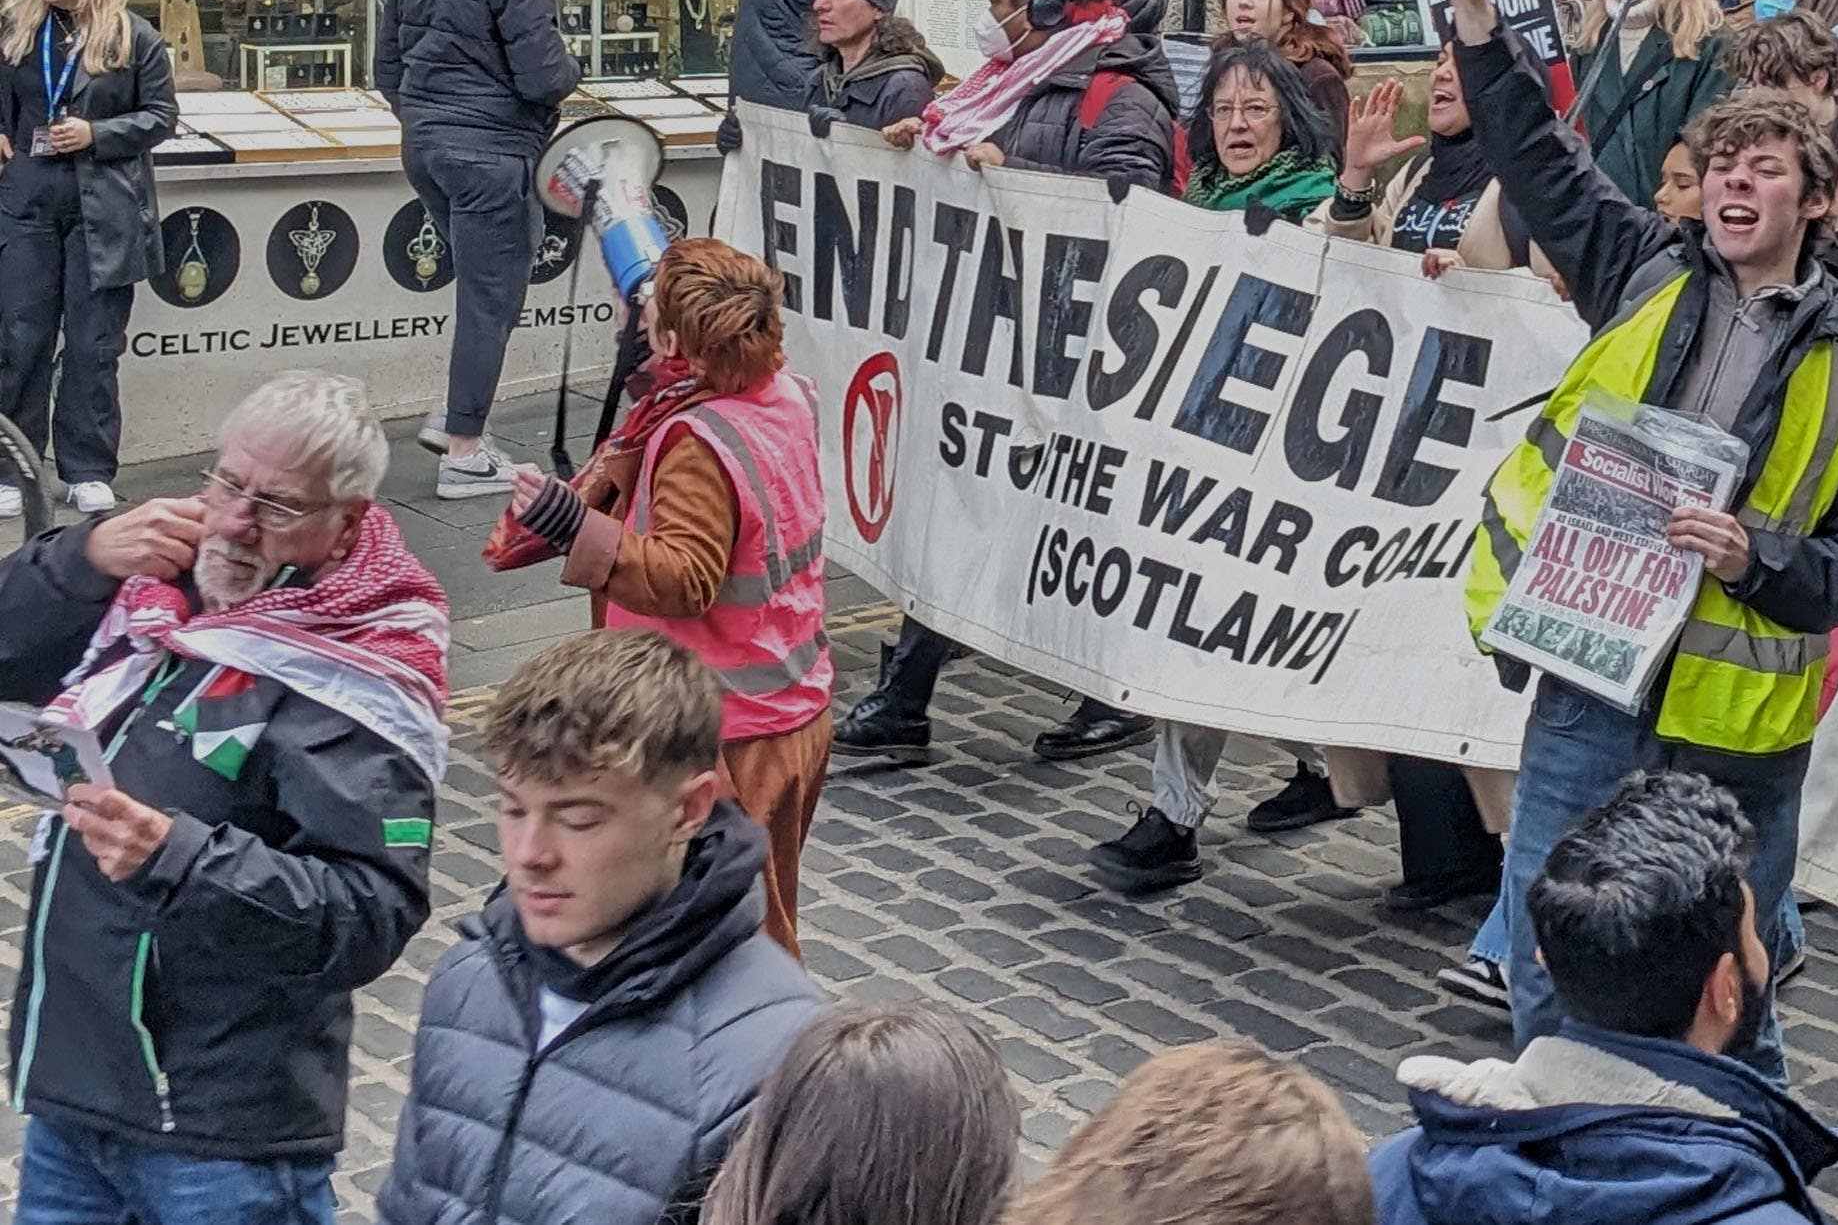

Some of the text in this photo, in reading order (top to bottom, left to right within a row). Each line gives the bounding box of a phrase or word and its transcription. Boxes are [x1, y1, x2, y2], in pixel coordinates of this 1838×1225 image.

[131, 301, 614, 358] CELTIC JEWELLERY EMSTO
[760, 158, 1493, 507] END THE SIEGE
[1045, 430, 1128, 516] THE
[1137, 459, 1315, 574] WAR
[1323, 518, 1481, 589] COALI
[1580, 444, 1711, 509] Socialist Worker
[1532, 521, 1689, 600] ALL OUT FOR
[1567, 517, 1594, 534] ISRAEL
[1594, 523, 1611, 537] AND
[1612, 529, 1635, 544] WEST
[1525, 562, 1663, 631] PALESTINE
